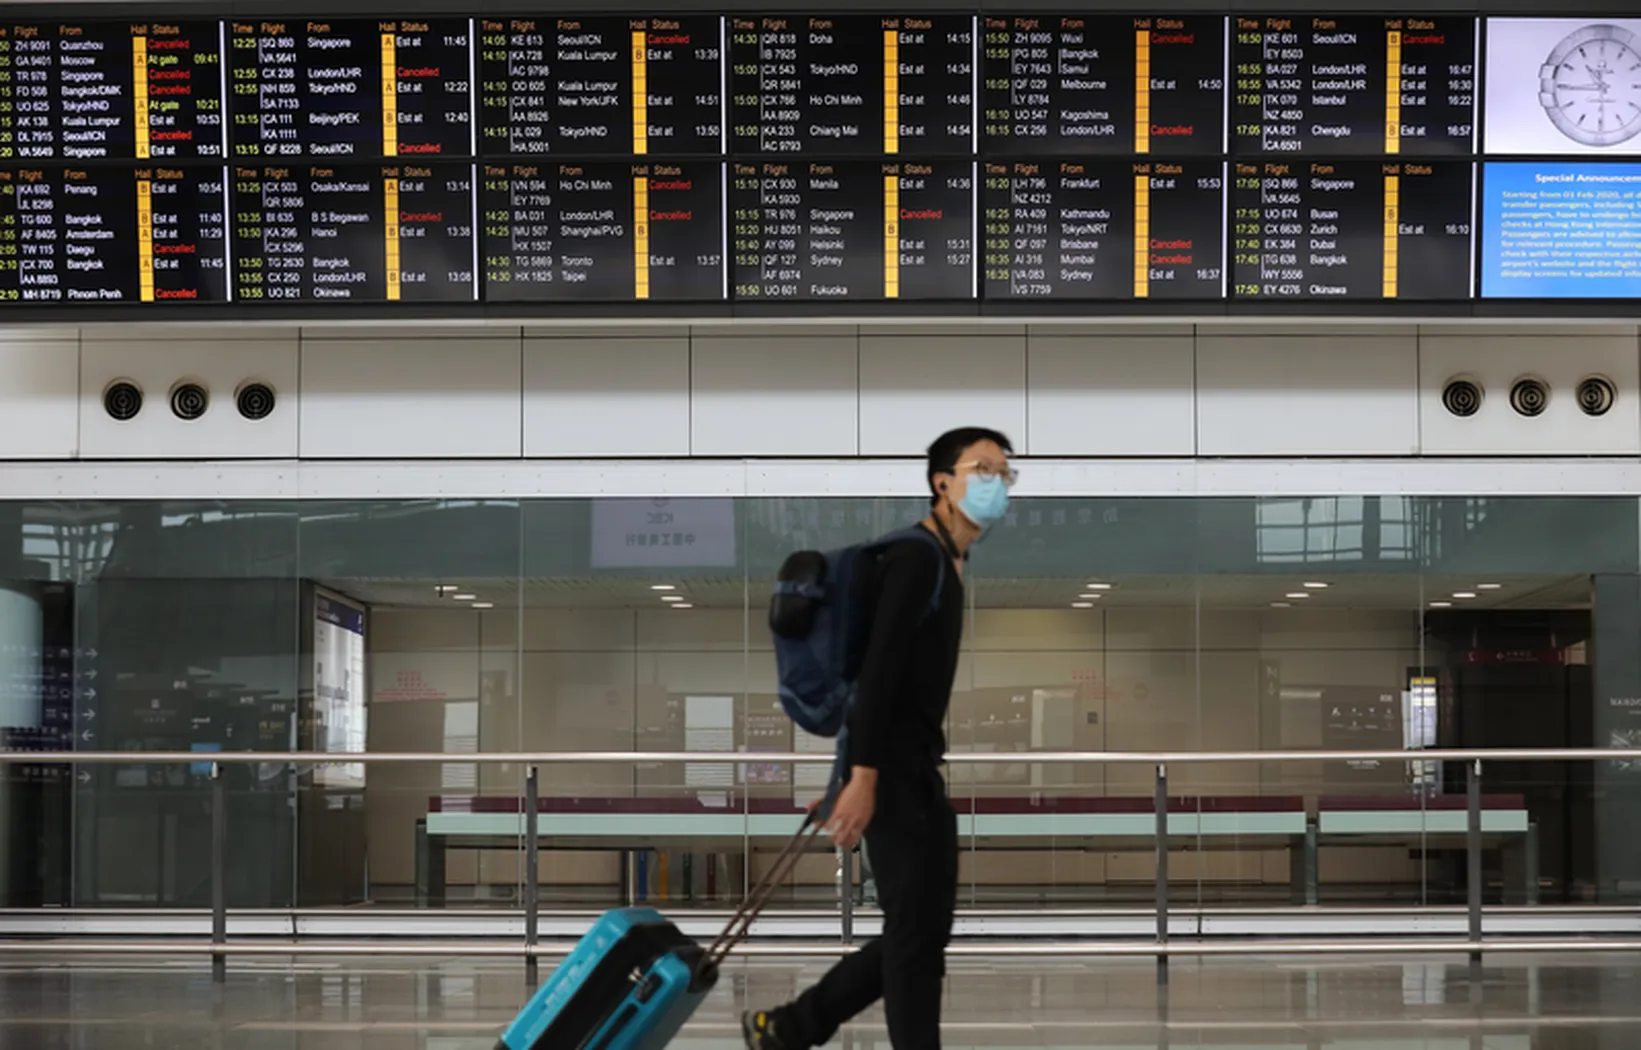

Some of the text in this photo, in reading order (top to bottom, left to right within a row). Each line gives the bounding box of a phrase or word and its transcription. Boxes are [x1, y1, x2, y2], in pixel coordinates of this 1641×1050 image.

[233, 21, 428, 35] Time Flight From Hall Status
[482, 19, 679, 32] Time Flight From Hall Status
[734, 18, 932, 31] Time Flight From Hall Status
[986, 18, 1184, 30] Time Flight From Hall Status
[1238, 18, 1434, 31] Time Flight From Hall Status
[14, 24, 179, 38] Flight From Hall Status
[308, 37, 351, 49] Singapore
[558, 35, 601, 45] Seoul/ICN
[646, 34, 689, 44] Cancelled
[810, 33, 833, 44] Doha
[1061, 34, 1083, 43] Wuxi
[1150, 33, 1194, 43] Cancelled
[1313, 34, 1356, 44] Seoul/ICN
[1401, 34, 1444, 44] Cancelled
[60, 39, 189, 50] Quanzhou Cancelled
[61, 56, 95, 65] Moscow
[146, 55, 158, 64] At
[159, 55, 178, 66] gate
[558, 51, 617, 61] Kuala Lumpur
[1060, 49, 1098, 61] Bangkok
[308, 67, 439, 78] London/LHR Cancelled
[1060, 63, 1088, 74] Samui
[1312, 64, 1366, 74] London/LHR
[61, 69, 190, 82] Singapore Cancelled
[148, 84, 190, 95] Cancelled
[558, 81, 617, 92] Kuala Lumpur
[1061, 80, 1106, 89] Melbourne
[1312, 80, 1366, 90] London/LHR
[558, 97, 578, 106] New
[810, 94, 862, 105] Ho Chi Minh
[1313, 96, 1346, 105] Istanbul
[147, 100, 159, 109] At
[160, 101, 179, 112] gate
[1061, 110, 1108, 121] Kagoshima
[62, 116, 120, 127] Kuala Lumpur
[63, 130, 192, 141] Seoul/ICN Cancelled
[810, 125, 858, 137] Chiang Mai
[1061, 125, 1193, 135] London/LHR Cancelled
[1312, 125, 1350, 137] Chengdu
[63, 146, 106, 158] Singapore
[310, 143, 440, 154] Seoul/ICN Cancelled
[810, 179, 839, 189] Manila
[1061, 178, 1099, 188] Frankfurt
[1536, 174, 1574, 183] Special
[65, 184, 97, 196] Penang
[560, 180, 691, 190] Ho Chi Minh Cancelled
[1311, 179, 1354, 191] Singapore
[329, 212, 369, 224] Begawan
[398, 211, 442, 222] Cancelled
[560, 210, 691, 221] London/LHR Cancelled
[810, 209, 942, 221] Singapore Cancelled
[1061, 209, 1110, 219] Kathmandu
[1311, 209, 1338, 219] Busan
[65, 214, 102, 226] Bangkok
[66, 230, 114, 239] Amsterdam
[312, 228, 337, 237] Hanoi
[810, 225, 840, 234] Haikou
[1310, 224, 1337, 234] Zurich
[67, 243, 195, 256] Daegu Cancelled
[810, 240, 844, 250] Helsinki
[1061, 239, 1192, 249] Brisbane Cancelled
[1310, 239, 1335, 249] Dubai
[313, 258, 349, 269] Bangkok
[561, 256, 593, 266] Toronto
[811, 254, 843, 267] Sydney
[1061, 254, 1192, 264] Mumbai Cancelled
[1310, 254, 1347, 266] Bangkok
[67, 259, 103, 271] Bangkok
[313, 272, 366, 283] London/LHR
[562, 271, 586, 282] Taipei
[1061, 269, 1093, 281] Sydney
[68, 289, 197, 299] Phnom Penh Cancelled
[314, 287, 350, 297] Okinawa
[811, 285, 847, 295] Fukuoka
[1309, 285, 1346, 294] Okinawa
